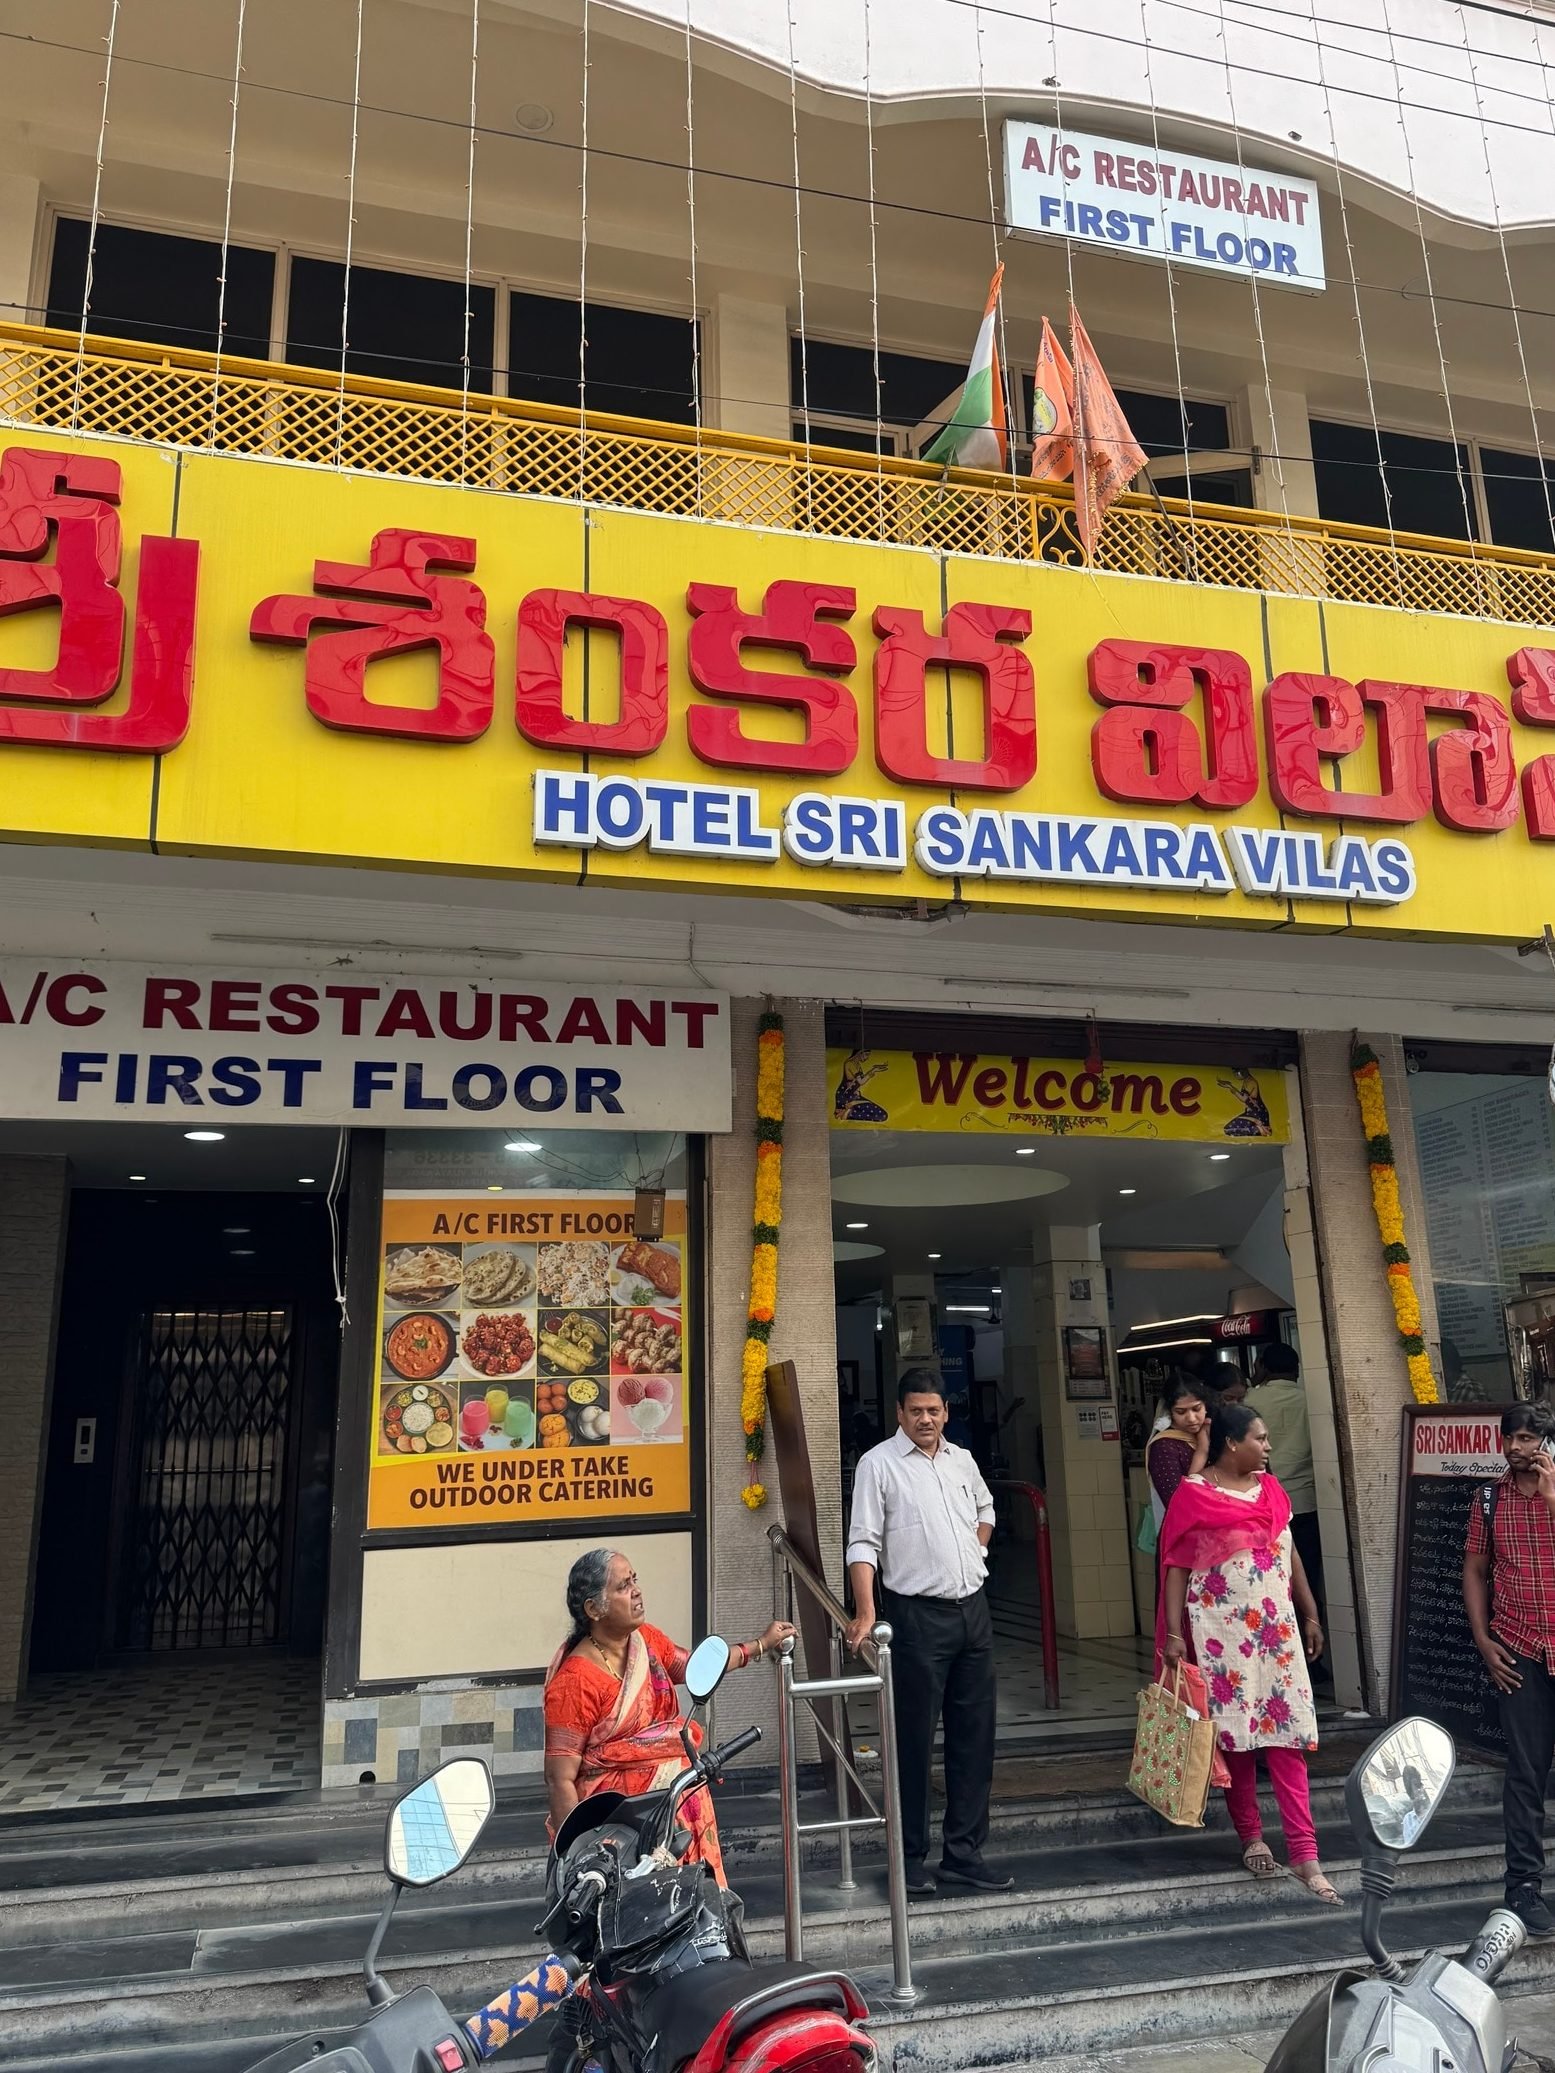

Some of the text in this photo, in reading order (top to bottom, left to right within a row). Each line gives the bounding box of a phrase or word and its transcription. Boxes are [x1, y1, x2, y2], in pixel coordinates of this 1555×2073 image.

[1021, 134, 1309, 226] A/C RESTAURANT
[1039, 195, 1299, 275] FIRST FLOOR
[250, 527, 1038, 794] శంకర
[544, 777, 1411, 895] HOTEL SRI SANKARA VILAS
[143, 977, 720, 1049] RESTAURANT
[60, 1052, 626, 1115] FIRST FLOOR
[912, 1051, 1202, 1117] Welcome
[432, 1212, 480, 1236] A/C
[487, 1212, 554, 1235] FIRST
[436, 1455, 630, 1484] WE UNDER TAKE
[1416, 1424, 1436, 1454] SRI
[1438, 1424, 1492, 1454] SANKAR
[1440, 1461, 1468, 1475] Today
[409, 1477, 654, 1510] OUTDOOR CATERING
